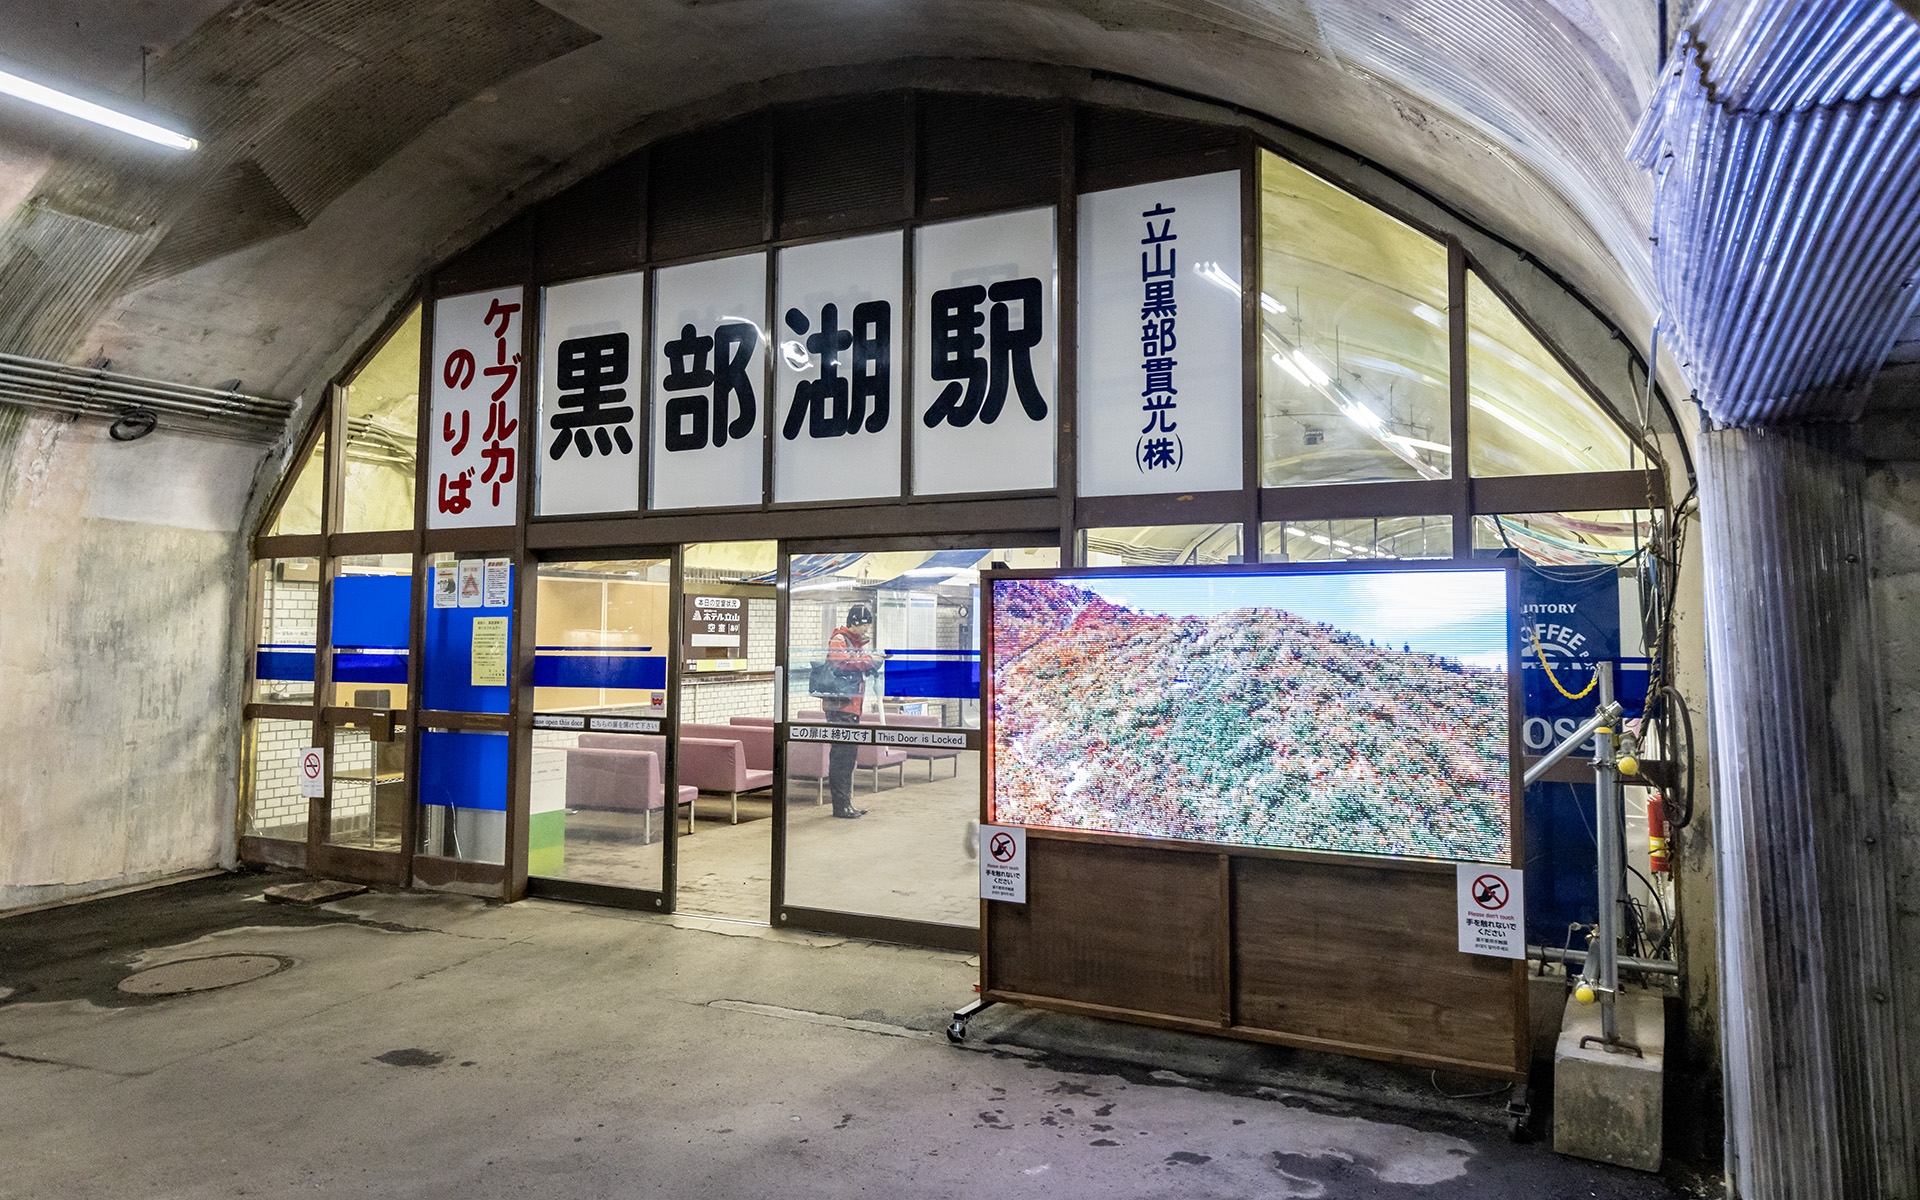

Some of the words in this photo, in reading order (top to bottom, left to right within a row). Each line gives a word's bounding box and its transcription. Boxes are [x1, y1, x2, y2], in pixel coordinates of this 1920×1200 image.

[1135, 202, 1184, 474] 立山黒部貫光(株)
[548, 276, 1049, 462] 黒部湖駅
[480, 298, 522, 507] ケーブルカー
[438, 348, 476, 514] のりば
[703, 612, 740, 621] ホテル立山
[1520, 623, 1587, 651] OFFEE
[545, 720, 559, 728] open
[559, 718, 570, 726] this
[878, 731, 895, 742] This
[897, 733, 918, 744] Door
[921, 733, 929, 743] is
[931, 734, 965, 745] Locked.
[1466, 918, 1517, 930] 手を触れないで
[1478, 928, 1506, 937] ください
